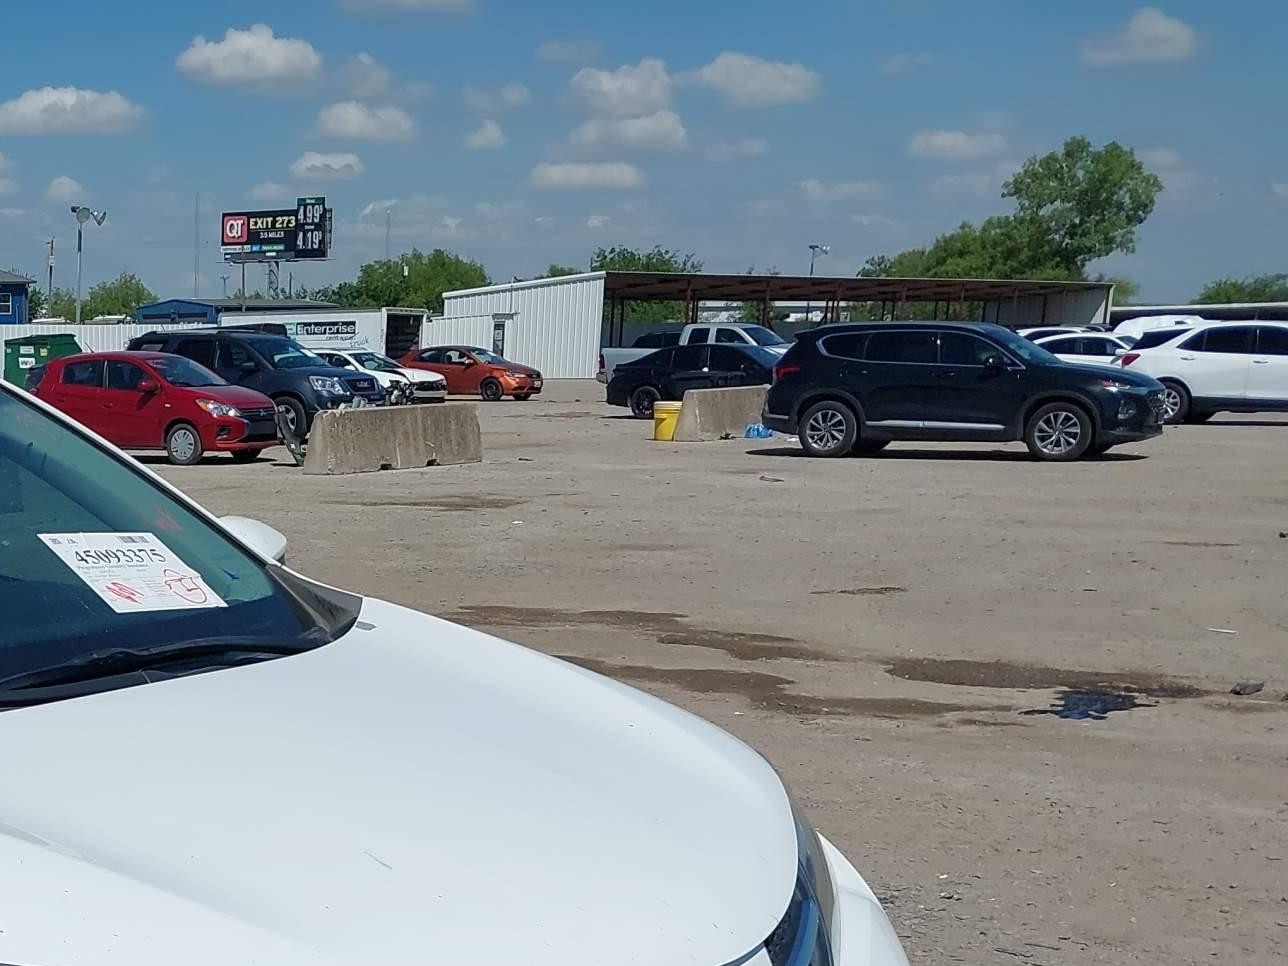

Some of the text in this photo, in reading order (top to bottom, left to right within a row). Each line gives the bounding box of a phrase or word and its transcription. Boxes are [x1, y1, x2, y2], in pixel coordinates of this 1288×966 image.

[226, 219, 244, 238] QT
[249, 216, 296, 229] EXIT 273
[297, 323, 355, 335] Enterprise
[74, 549, 167, 564] 45093375
